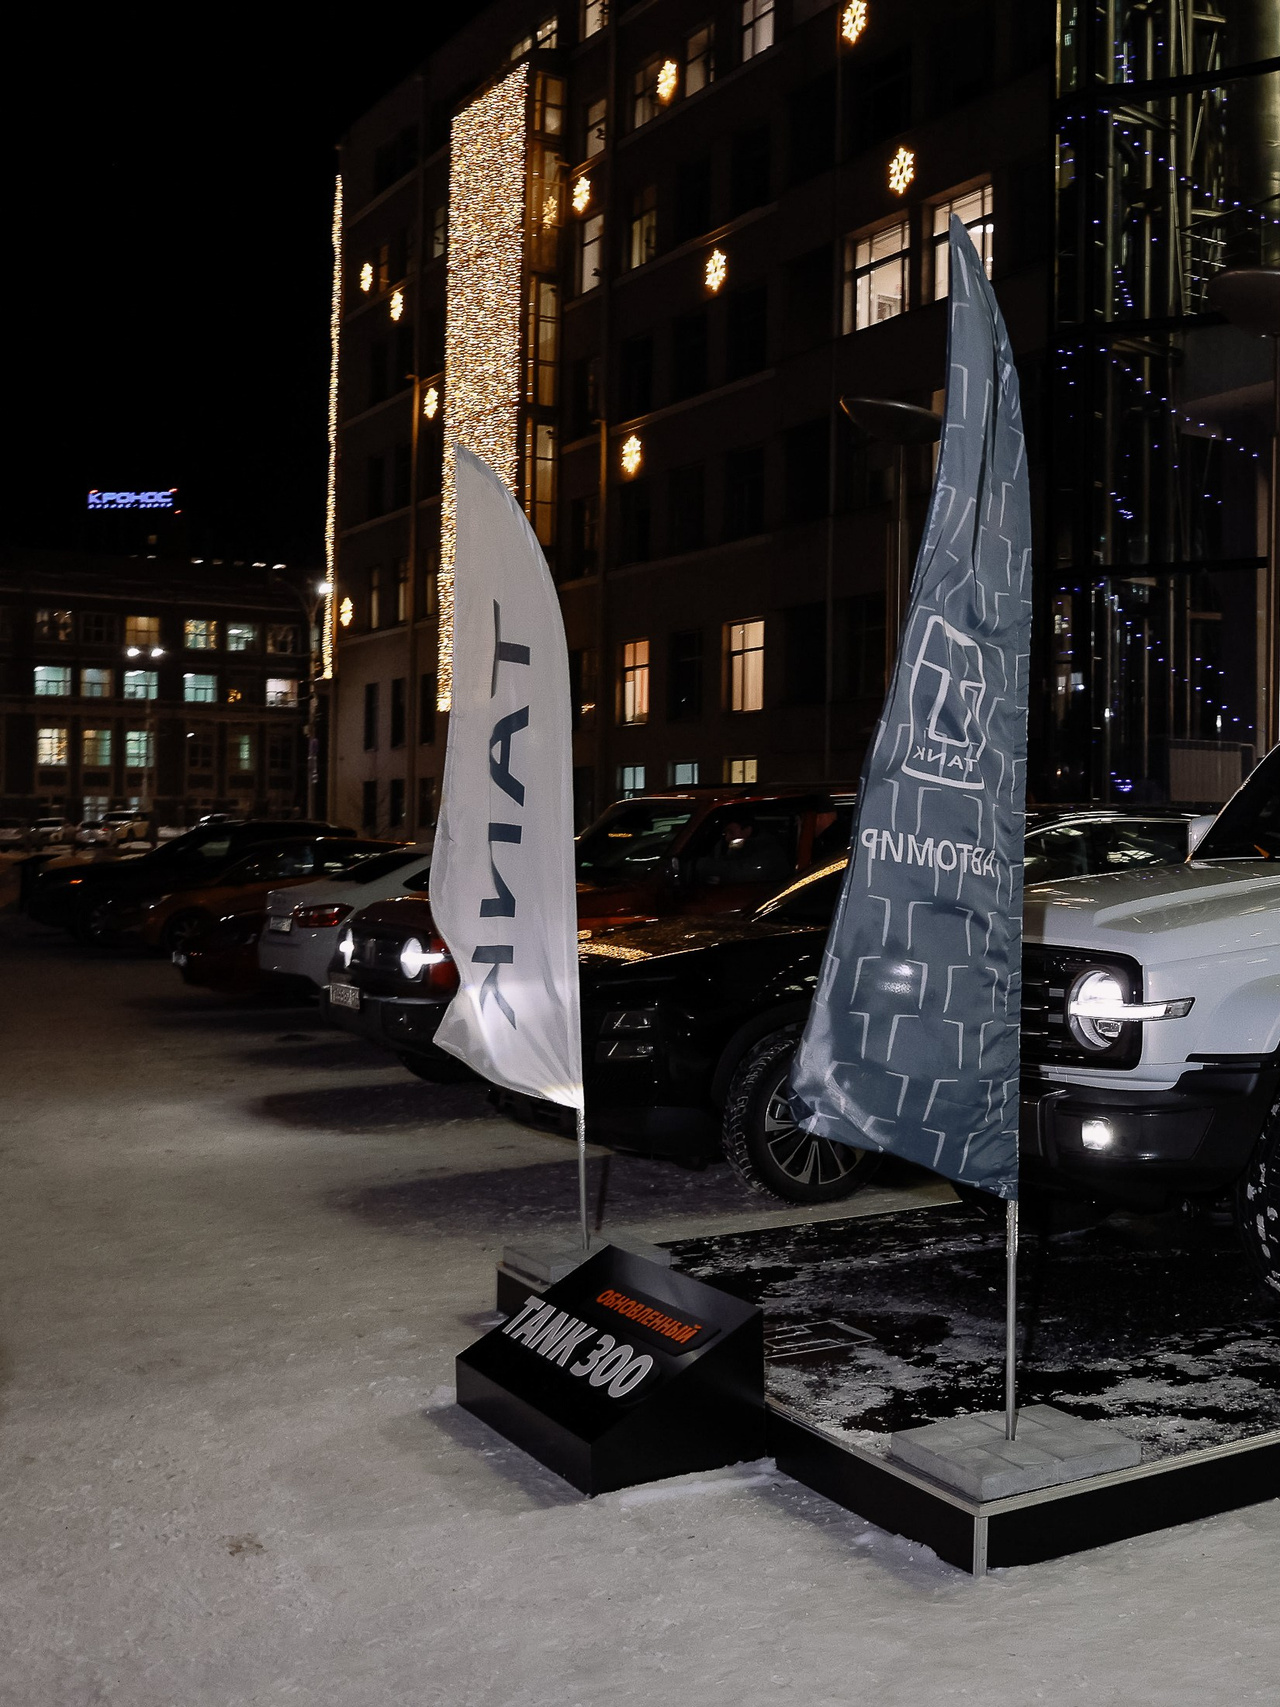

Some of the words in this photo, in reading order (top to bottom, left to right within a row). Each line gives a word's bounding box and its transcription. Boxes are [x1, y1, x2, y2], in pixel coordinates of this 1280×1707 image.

[88, 492, 173, 503] КРОНОС
[596, 1289, 702, 1344] ОБНОВЛЕННЫЙ
[502, 1295, 598, 1367] TANK
[569, 1334, 654, 1398] 300
